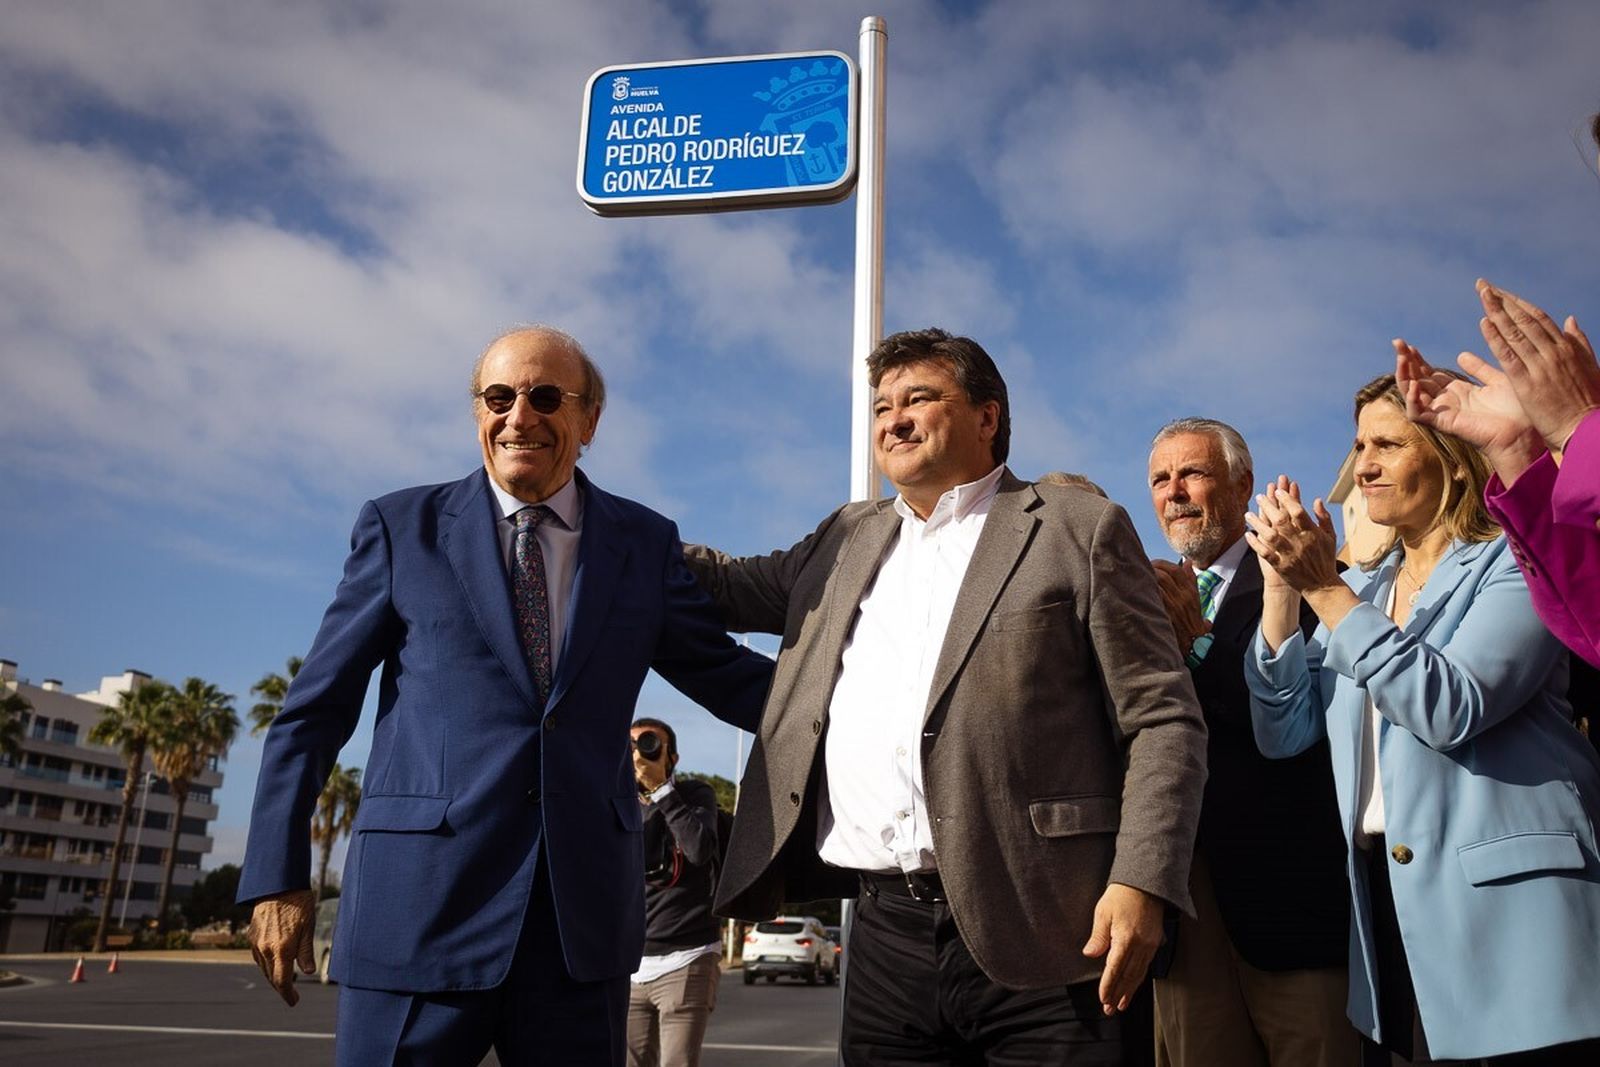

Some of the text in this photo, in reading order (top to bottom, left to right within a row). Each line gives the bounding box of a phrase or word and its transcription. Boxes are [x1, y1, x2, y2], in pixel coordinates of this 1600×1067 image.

[610, 102, 664, 115] AVENIDA
[606, 114, 702, 141] ALCALDE
[605, 132, 806, 166] PEDRO RODRÍGUEZ
[603, 165, 715, 193] GONZÁLEZ
